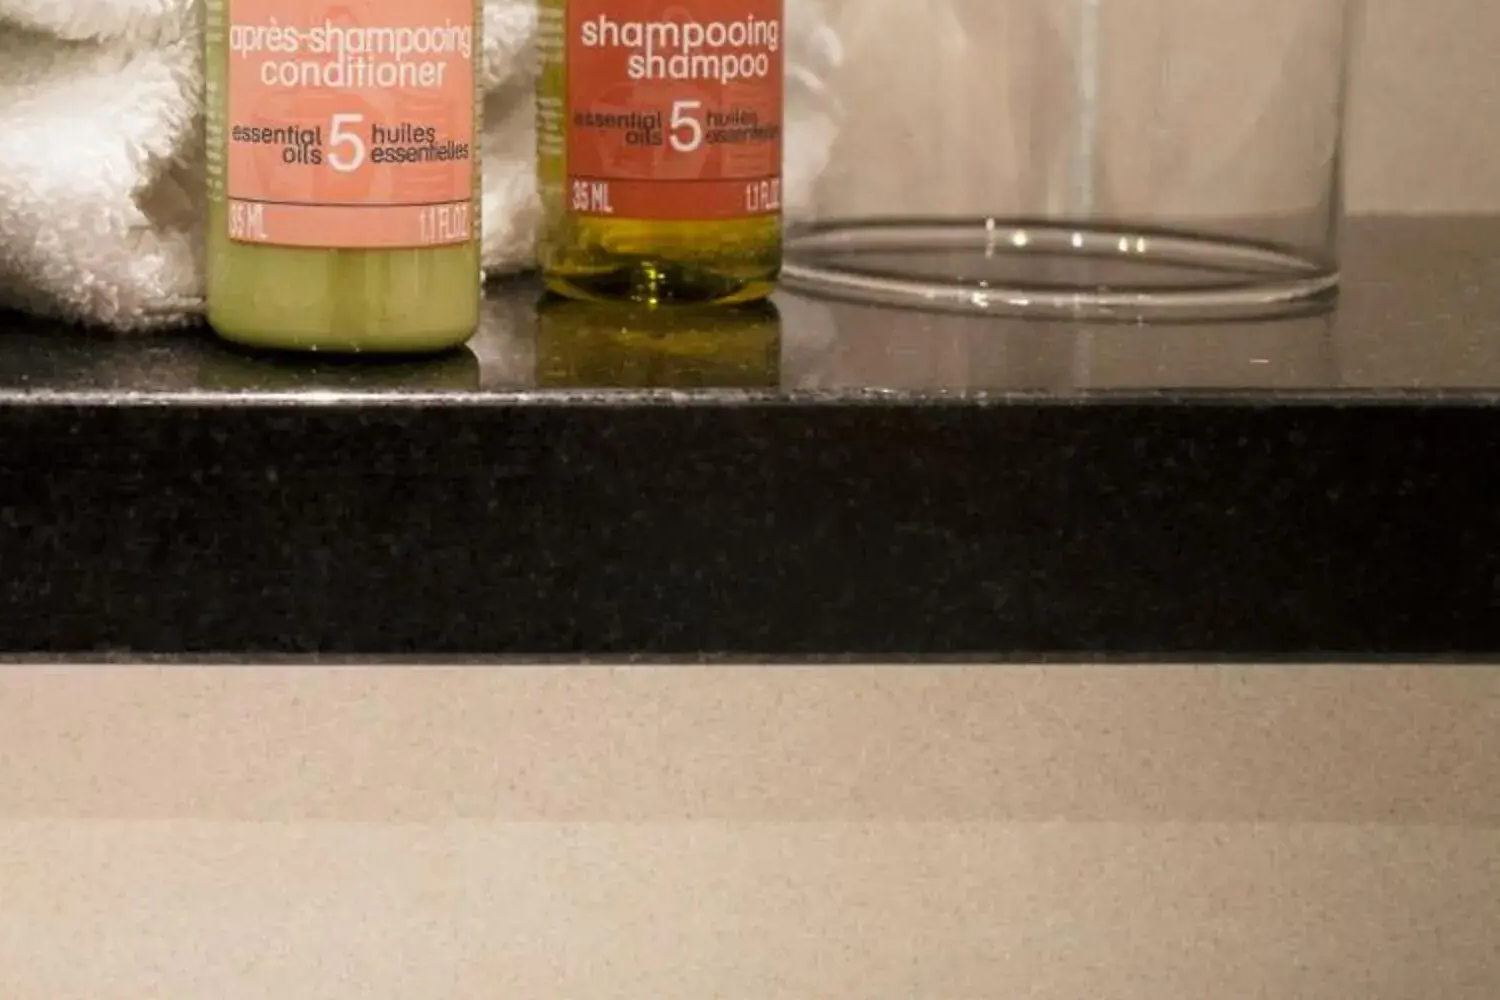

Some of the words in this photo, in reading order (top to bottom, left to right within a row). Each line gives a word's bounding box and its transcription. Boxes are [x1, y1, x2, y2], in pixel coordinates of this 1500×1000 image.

[230, 16, 472, 59] après-shampooing
[581, 14, 779, 52] shampooing
[261, 55, 447, 87] conditioner
[627, 48, 768, 84] shampoo
[232, 124, 323, 146] essential
[328, 113, 366, 172] 5
[371, 122, 436, 144] huiles
[625, 129, 663, 147] oils
[669, 100, 702, 152] 5
[282, 142, 323, 165] oils
[371, 140, 469, 163] essentielles
